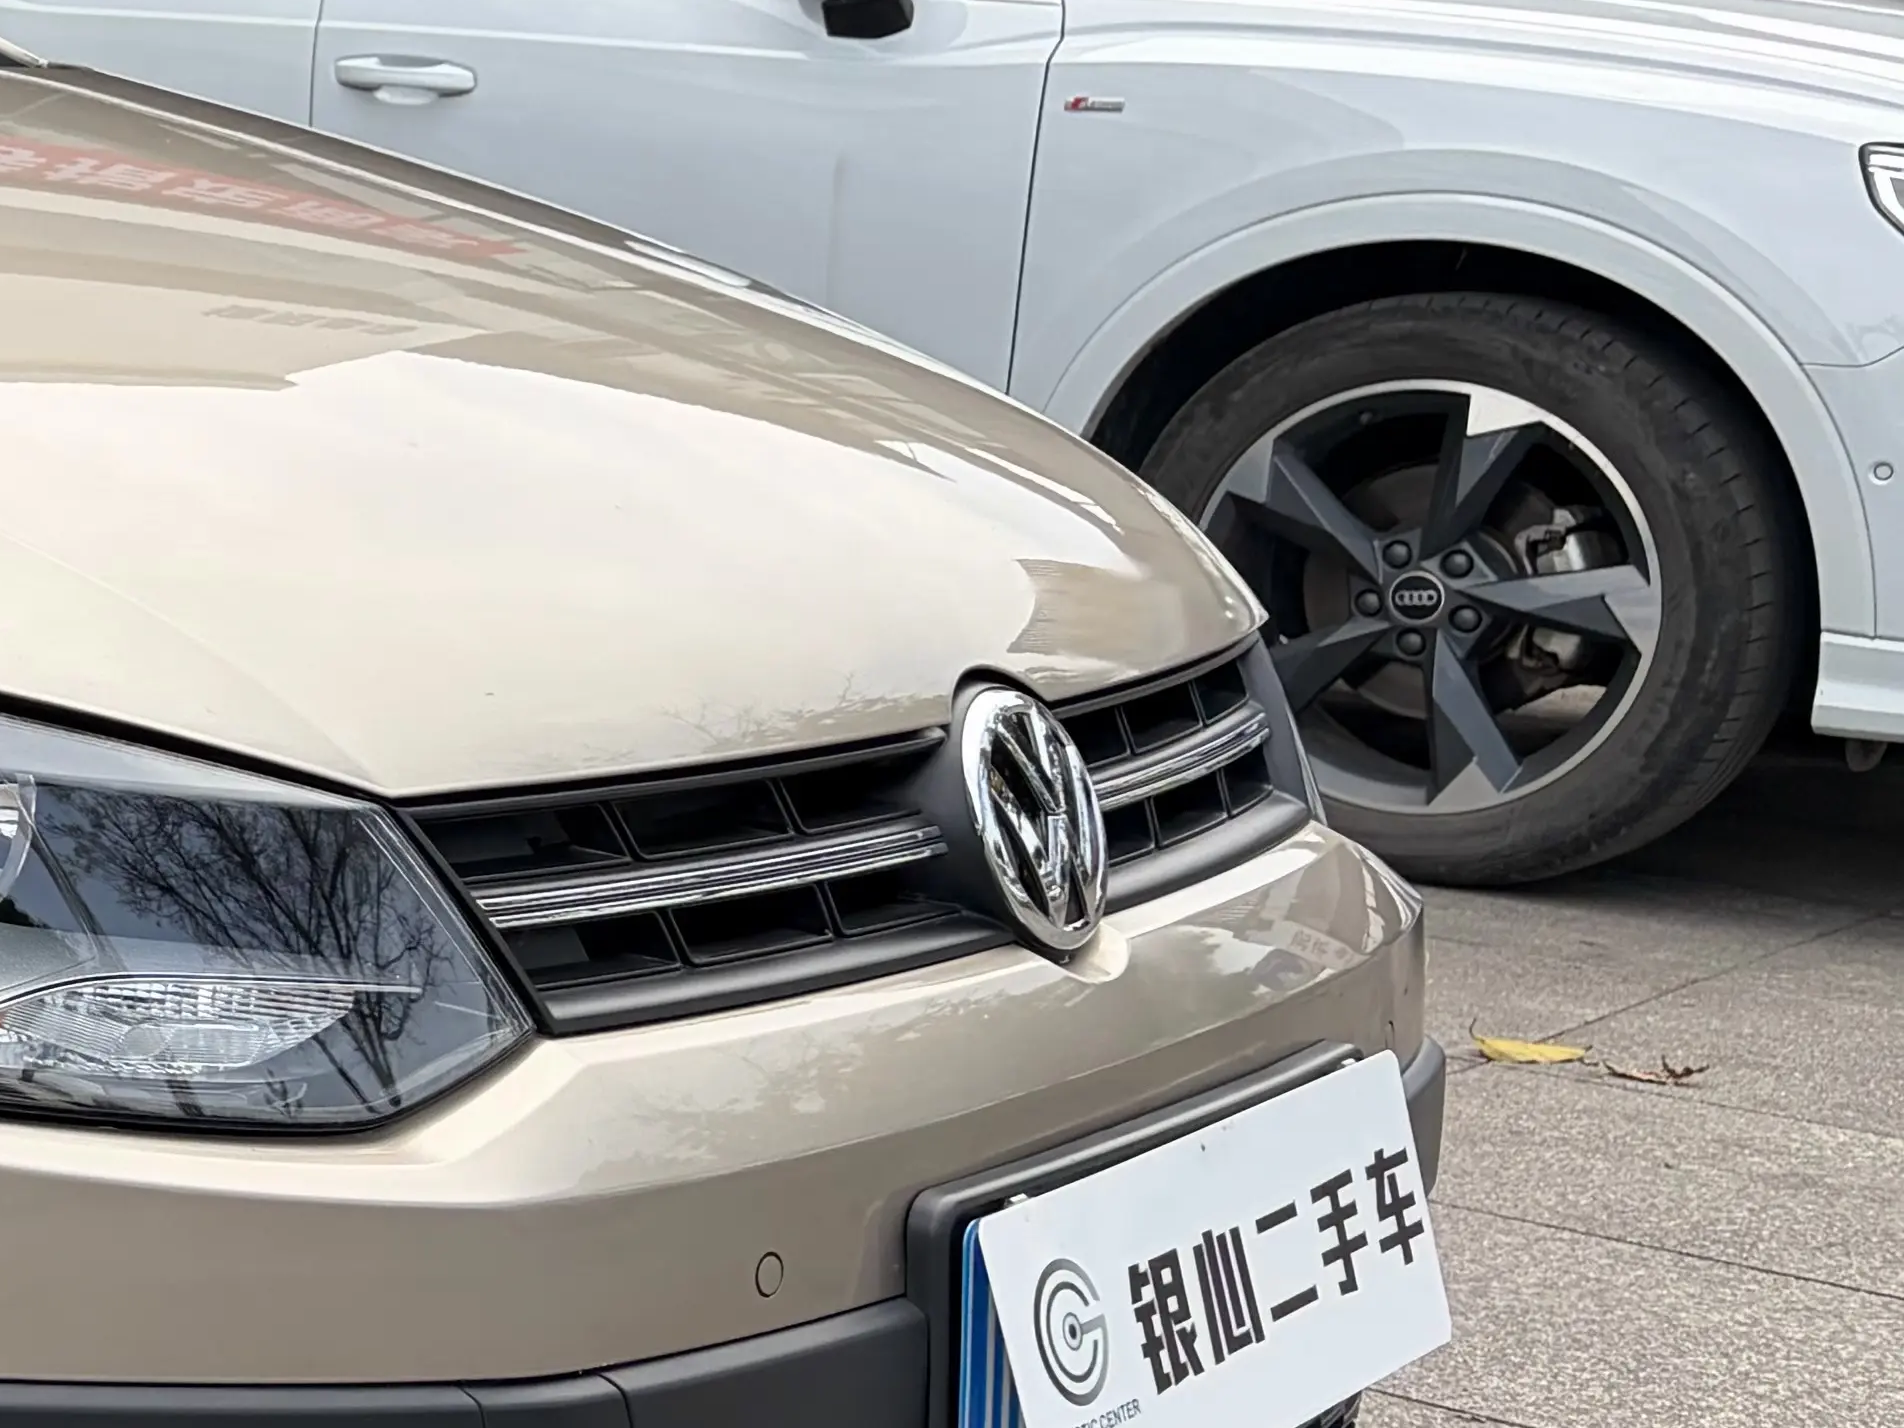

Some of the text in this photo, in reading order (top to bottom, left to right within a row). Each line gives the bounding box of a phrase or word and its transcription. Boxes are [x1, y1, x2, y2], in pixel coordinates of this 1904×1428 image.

[1128, 1147, 1425, 1396] 银心二手车
